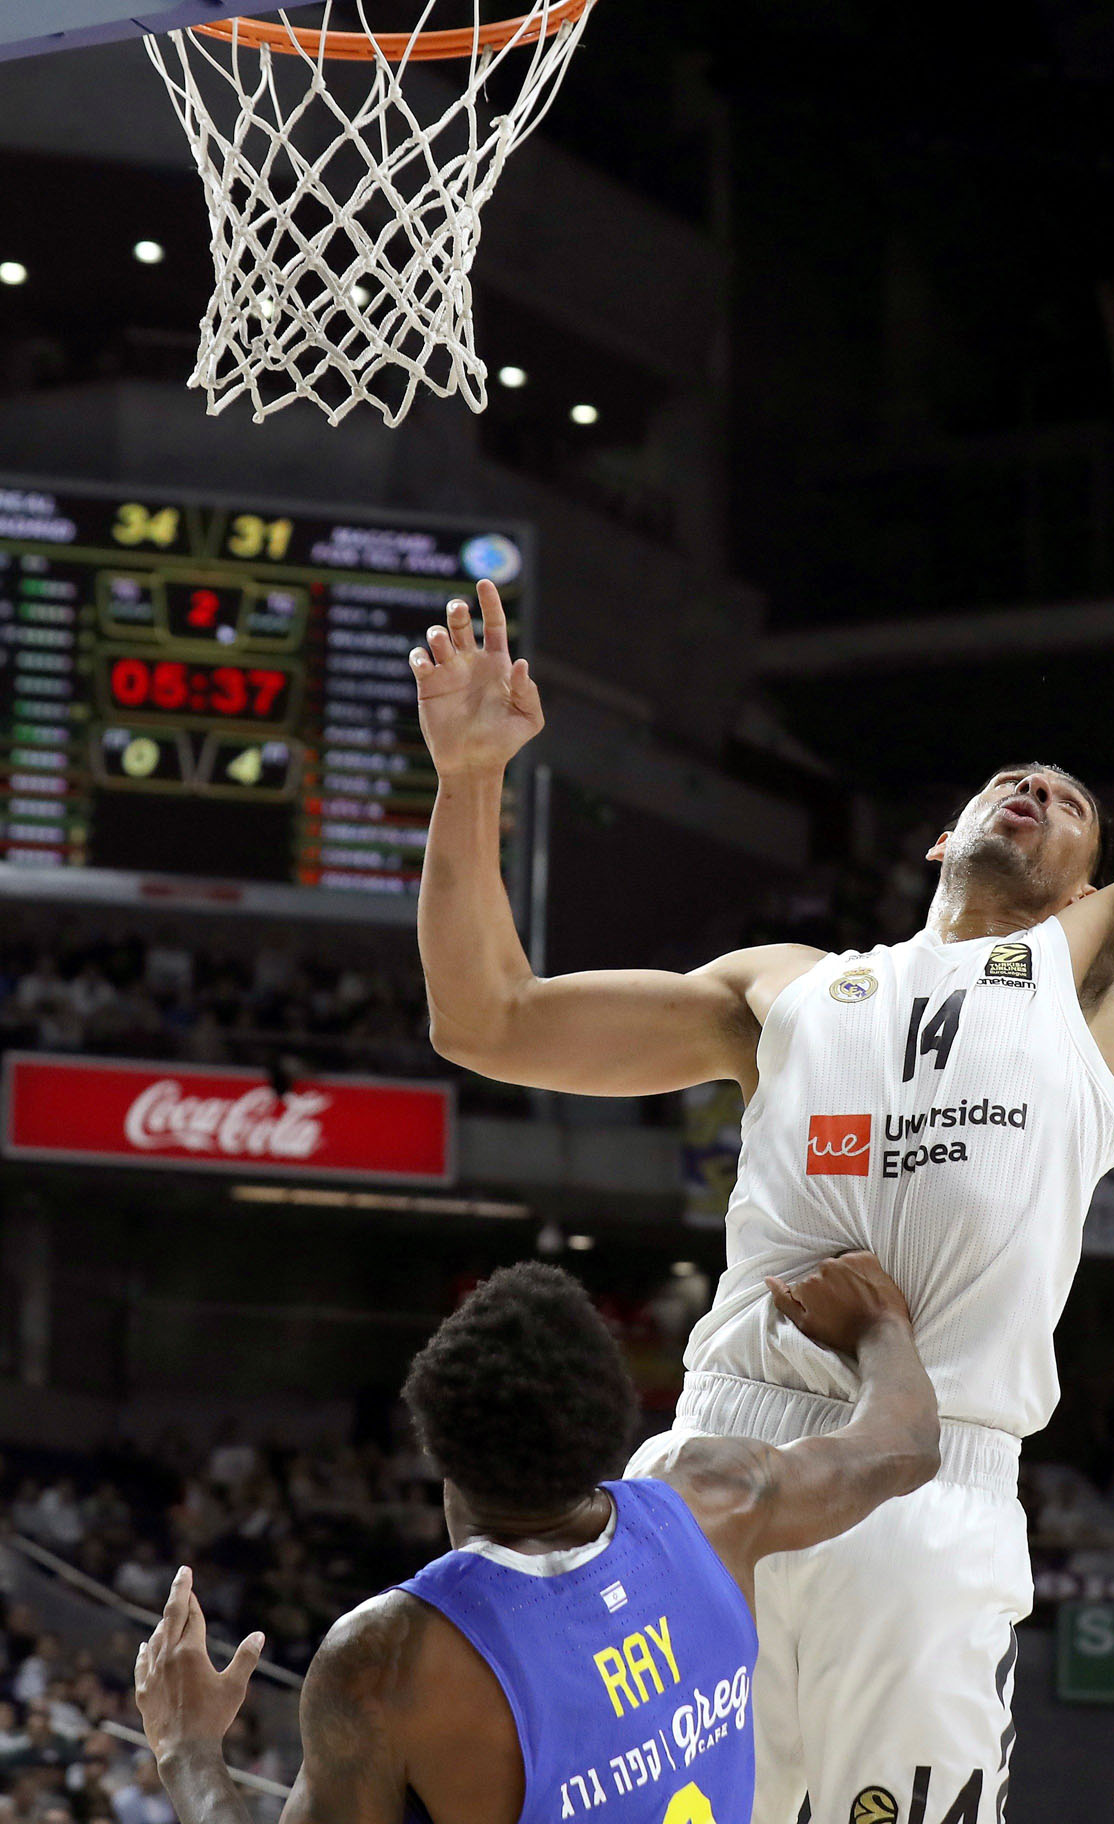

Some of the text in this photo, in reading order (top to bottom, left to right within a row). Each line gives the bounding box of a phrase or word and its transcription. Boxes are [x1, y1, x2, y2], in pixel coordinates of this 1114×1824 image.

[111, 502, 180, 547] 34
[228, 514, 293, 561] 31
[226, 746, 263, 786] 4
[976, 977, 1037, 989] oneteam
[902, 988, 967, 1083] 14
[593, 1616, 681, 1718] RAY
[672, 1665, 750, 1767] greg
[698, 1722, 729, 1753] CAFE
[609, 1739, 662, 1796] קפה
[560, 1768, 607, 1820] גרג
